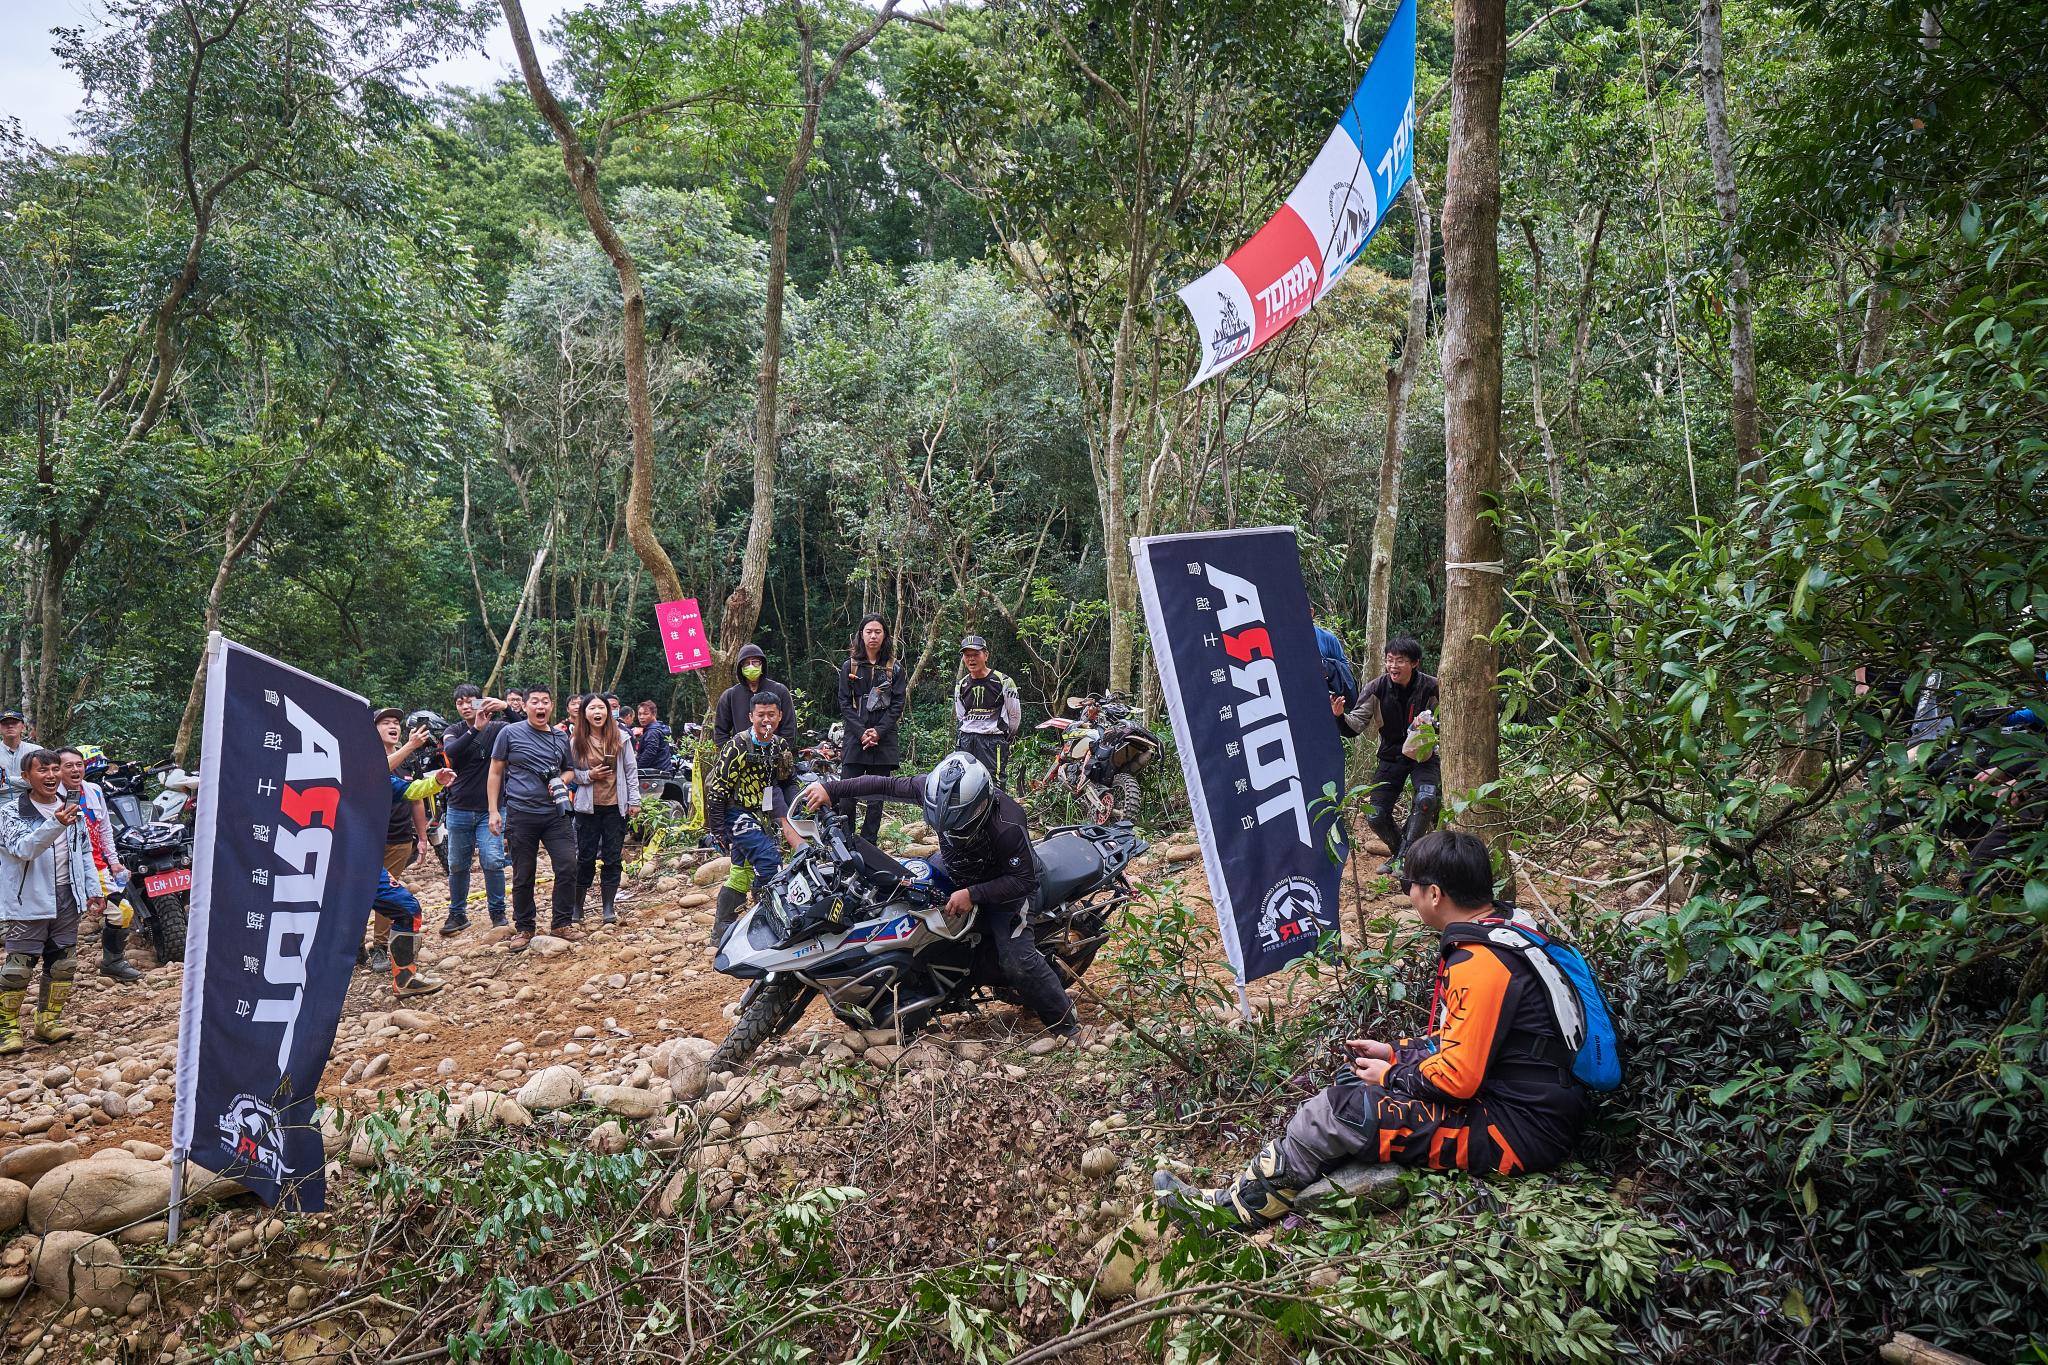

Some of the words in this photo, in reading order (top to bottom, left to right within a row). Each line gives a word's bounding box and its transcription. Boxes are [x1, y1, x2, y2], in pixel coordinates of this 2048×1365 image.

[1255, 256, 1317, 319] TORRA
[790, 880, 806, 903] 156
[1379, 1124, 1525, 1176] FOX
